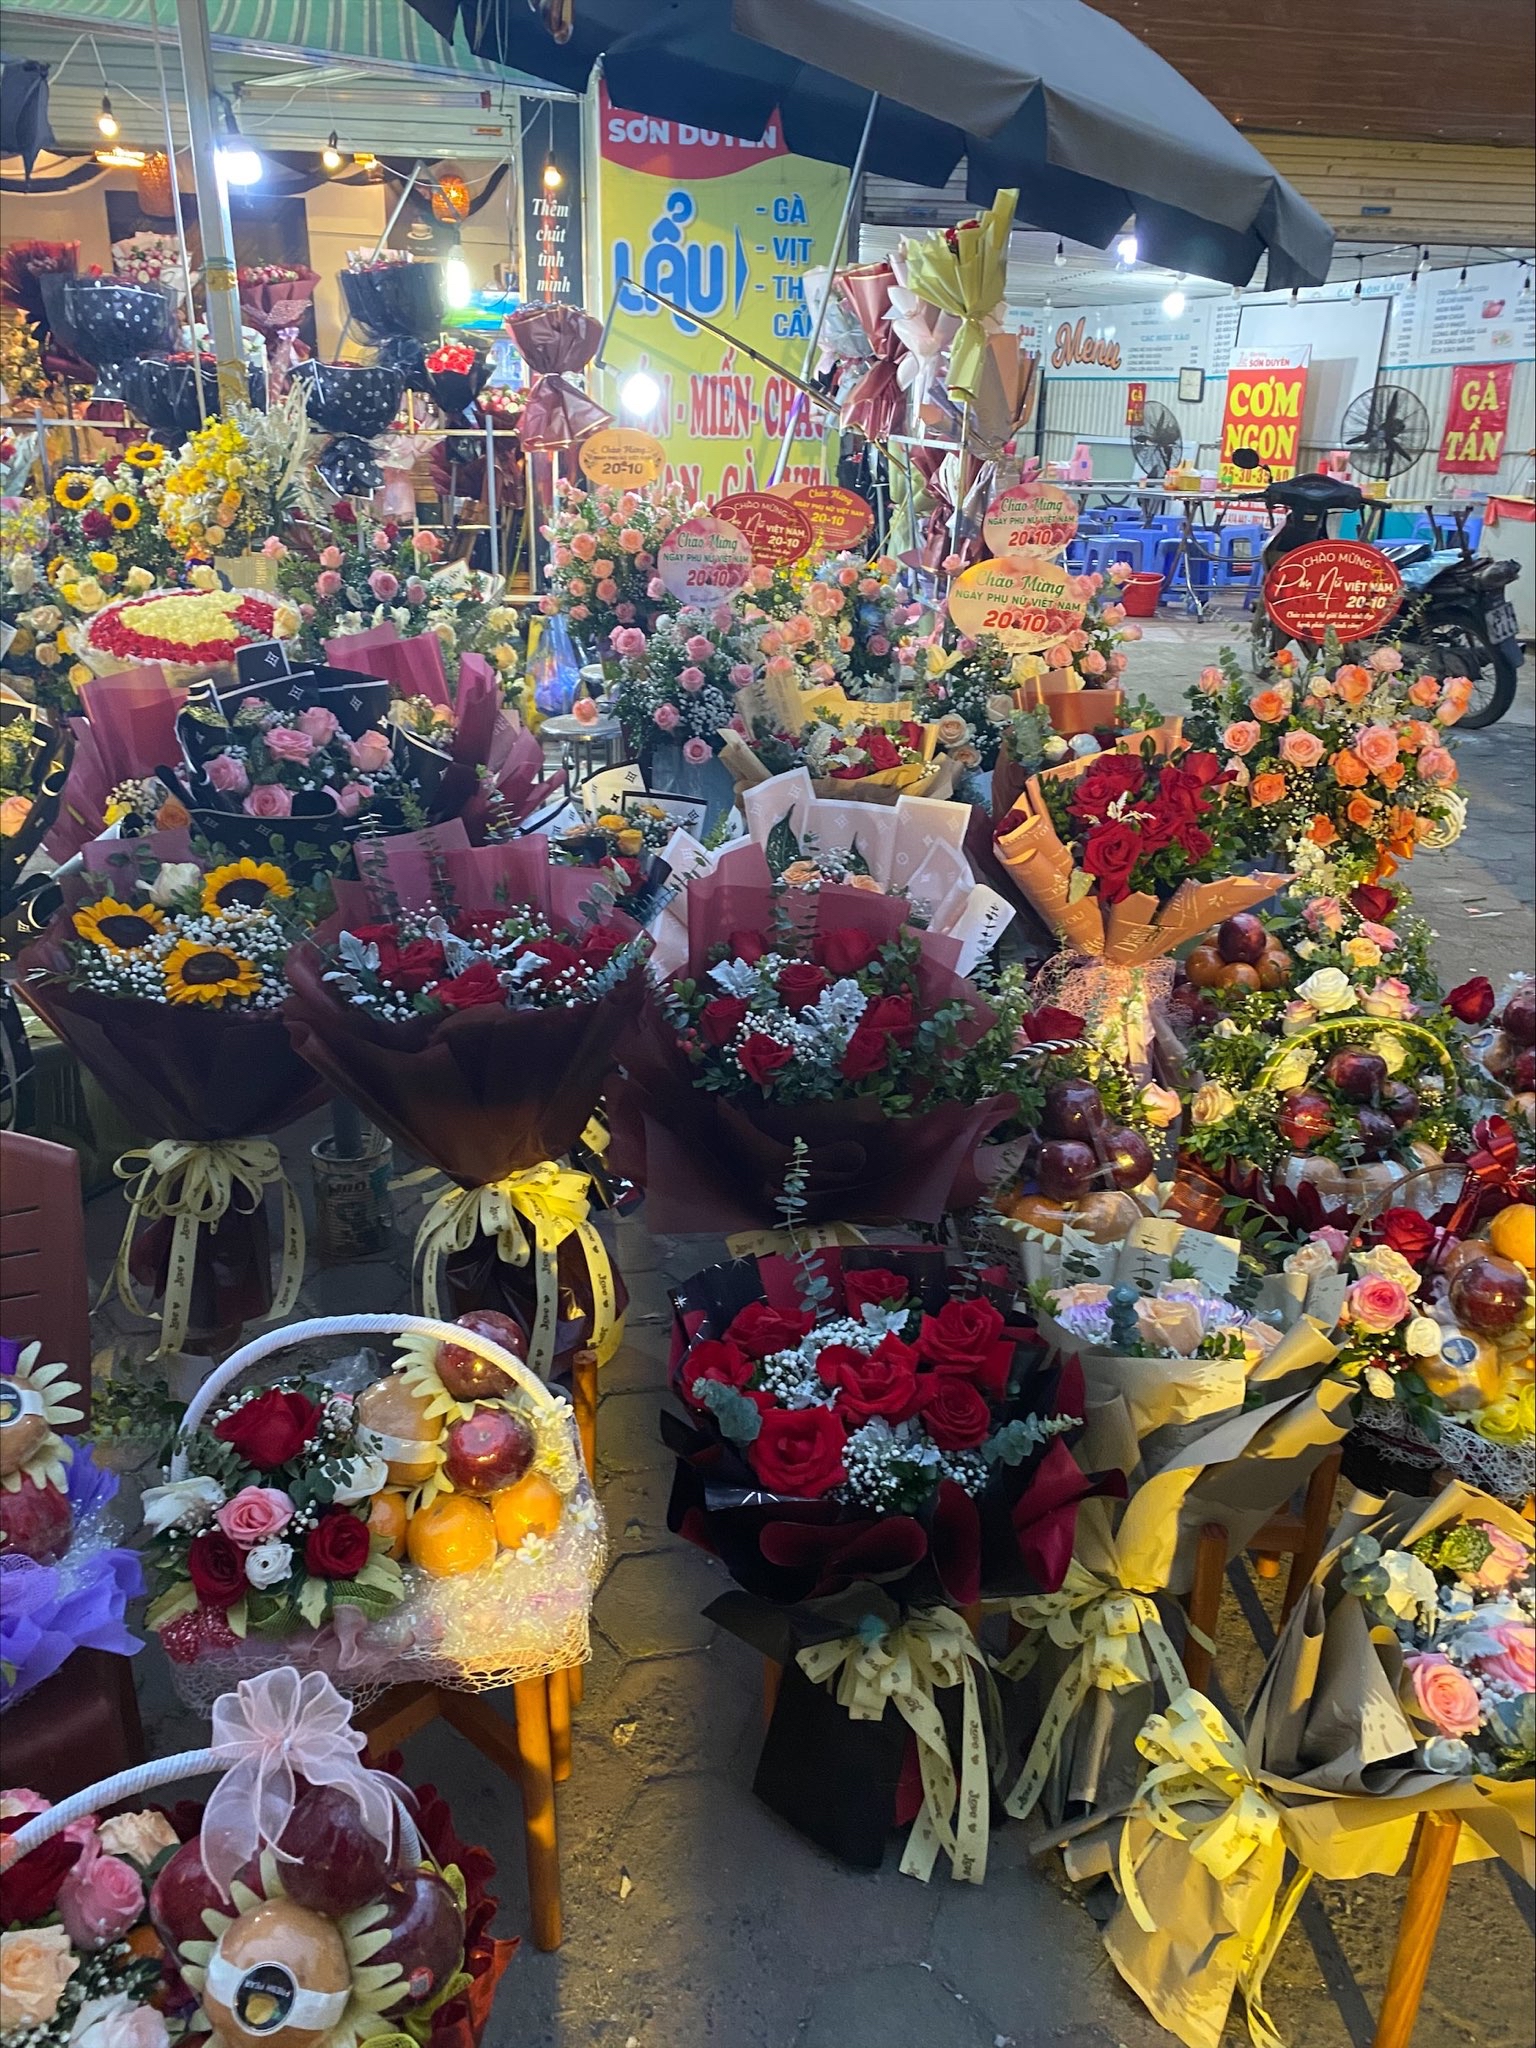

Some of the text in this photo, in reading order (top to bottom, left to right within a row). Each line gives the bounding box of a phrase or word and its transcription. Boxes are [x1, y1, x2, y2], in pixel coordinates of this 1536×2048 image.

[608, 115, 670, 144] SƠN
[532, 198, 569, 217] Thêm
[773, 192, 807, 225] GÀ
[536, 224, 566, 243] chút
[538, 250, 565, 268] tình
[772, 236, 814, 267] VỊT
[536, 275, 571, 293] mình
[1052, 316, 1122, 370] Menu
[1230, 375, 1302, 418] CƠM
[602, 462, 643, 475] 20-10
[811, 512, 845, 527] 20-10
[768, 535, 800, 549] 20-10
[1302, 551, 1373, 570] CHÀO MỪNG
[1344, 580, 1368, 595] VIỆT
[1369, 581, 1394, 593] NAM
[1058, 601, 1081, 612] NAM
[1345, 595, 1388, 609] 20-10
